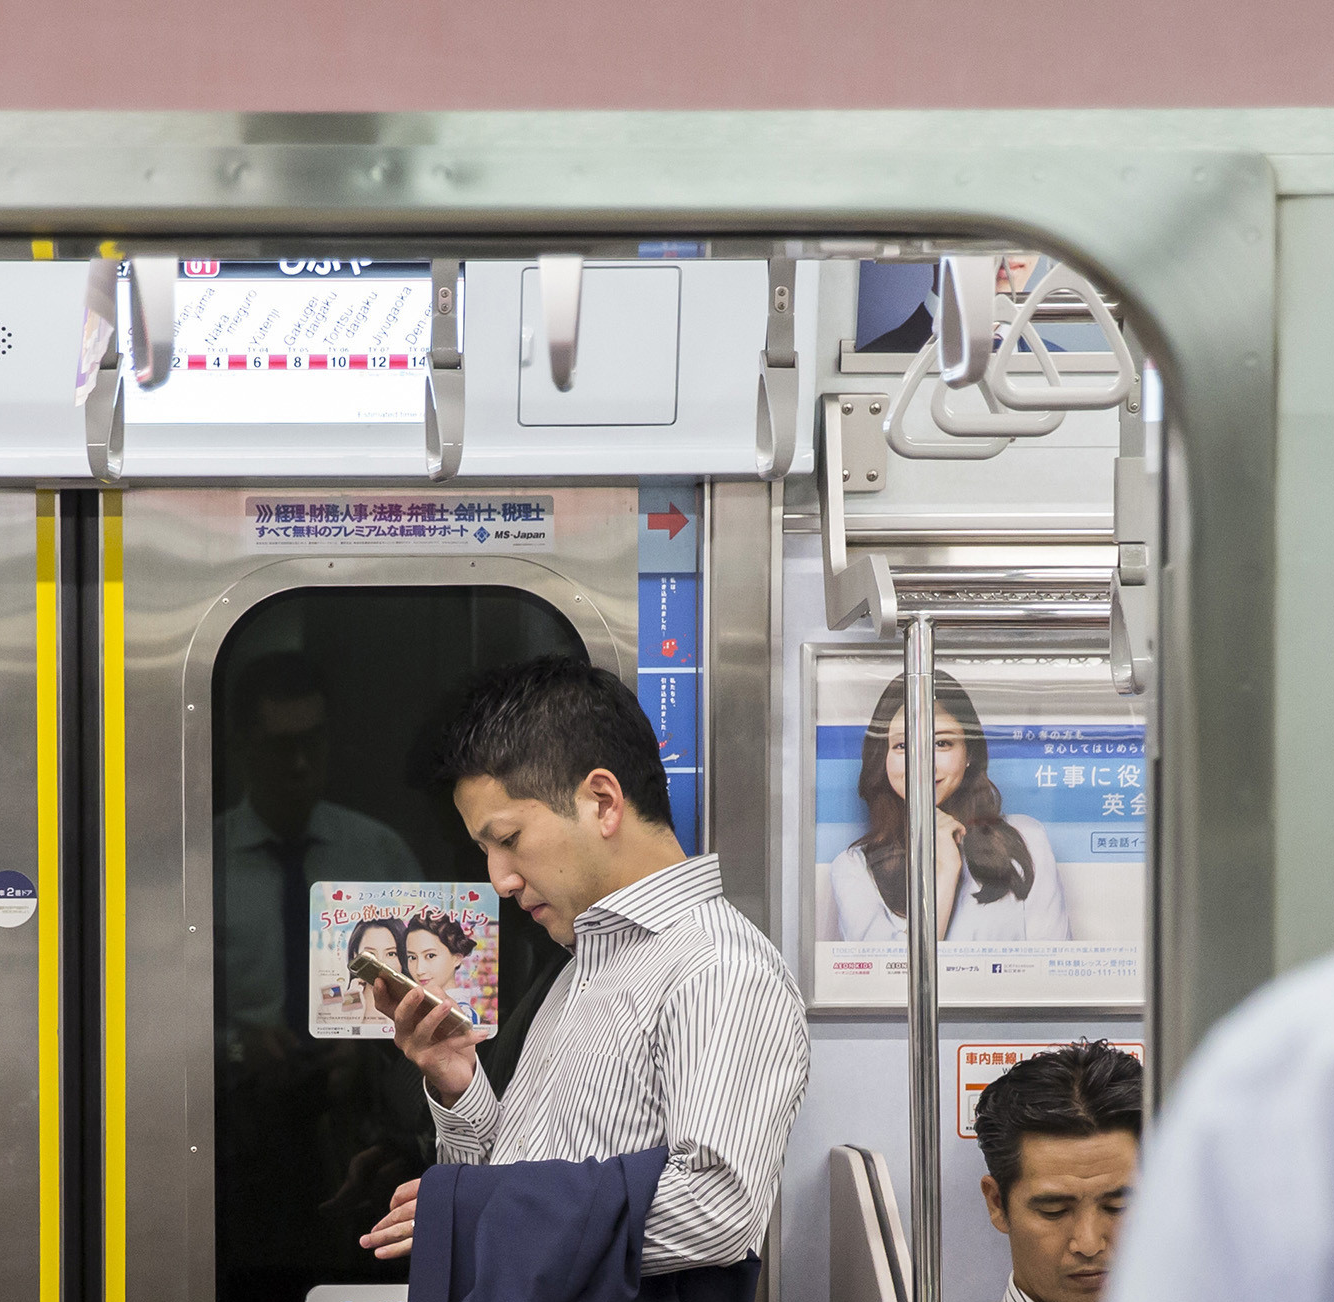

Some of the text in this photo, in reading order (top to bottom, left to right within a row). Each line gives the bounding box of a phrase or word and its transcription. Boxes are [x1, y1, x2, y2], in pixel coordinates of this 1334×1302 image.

[226, 289, 258, 335] meguro
[172, 356, 181, 368] 2
[212, 356, 221, 368] 4
[253, 356, 262, 368] 6
[293, 356, 302, 368] 8
[330, 356, 347, 368] 10
[372, 356, 387, 368] 12
[411, 356, 426, 368] 14
[255, 524, 469, 539] すべて無料のプレミアムな転職サポート
[494, 530, 546, 541] MS-Japan
[1034, 764, 1142, 789] 仕事に役
[1101, 792, 1147, 817] 英会
[320, 904, 490, 931] 5色の欲ばりアイシャドウ
